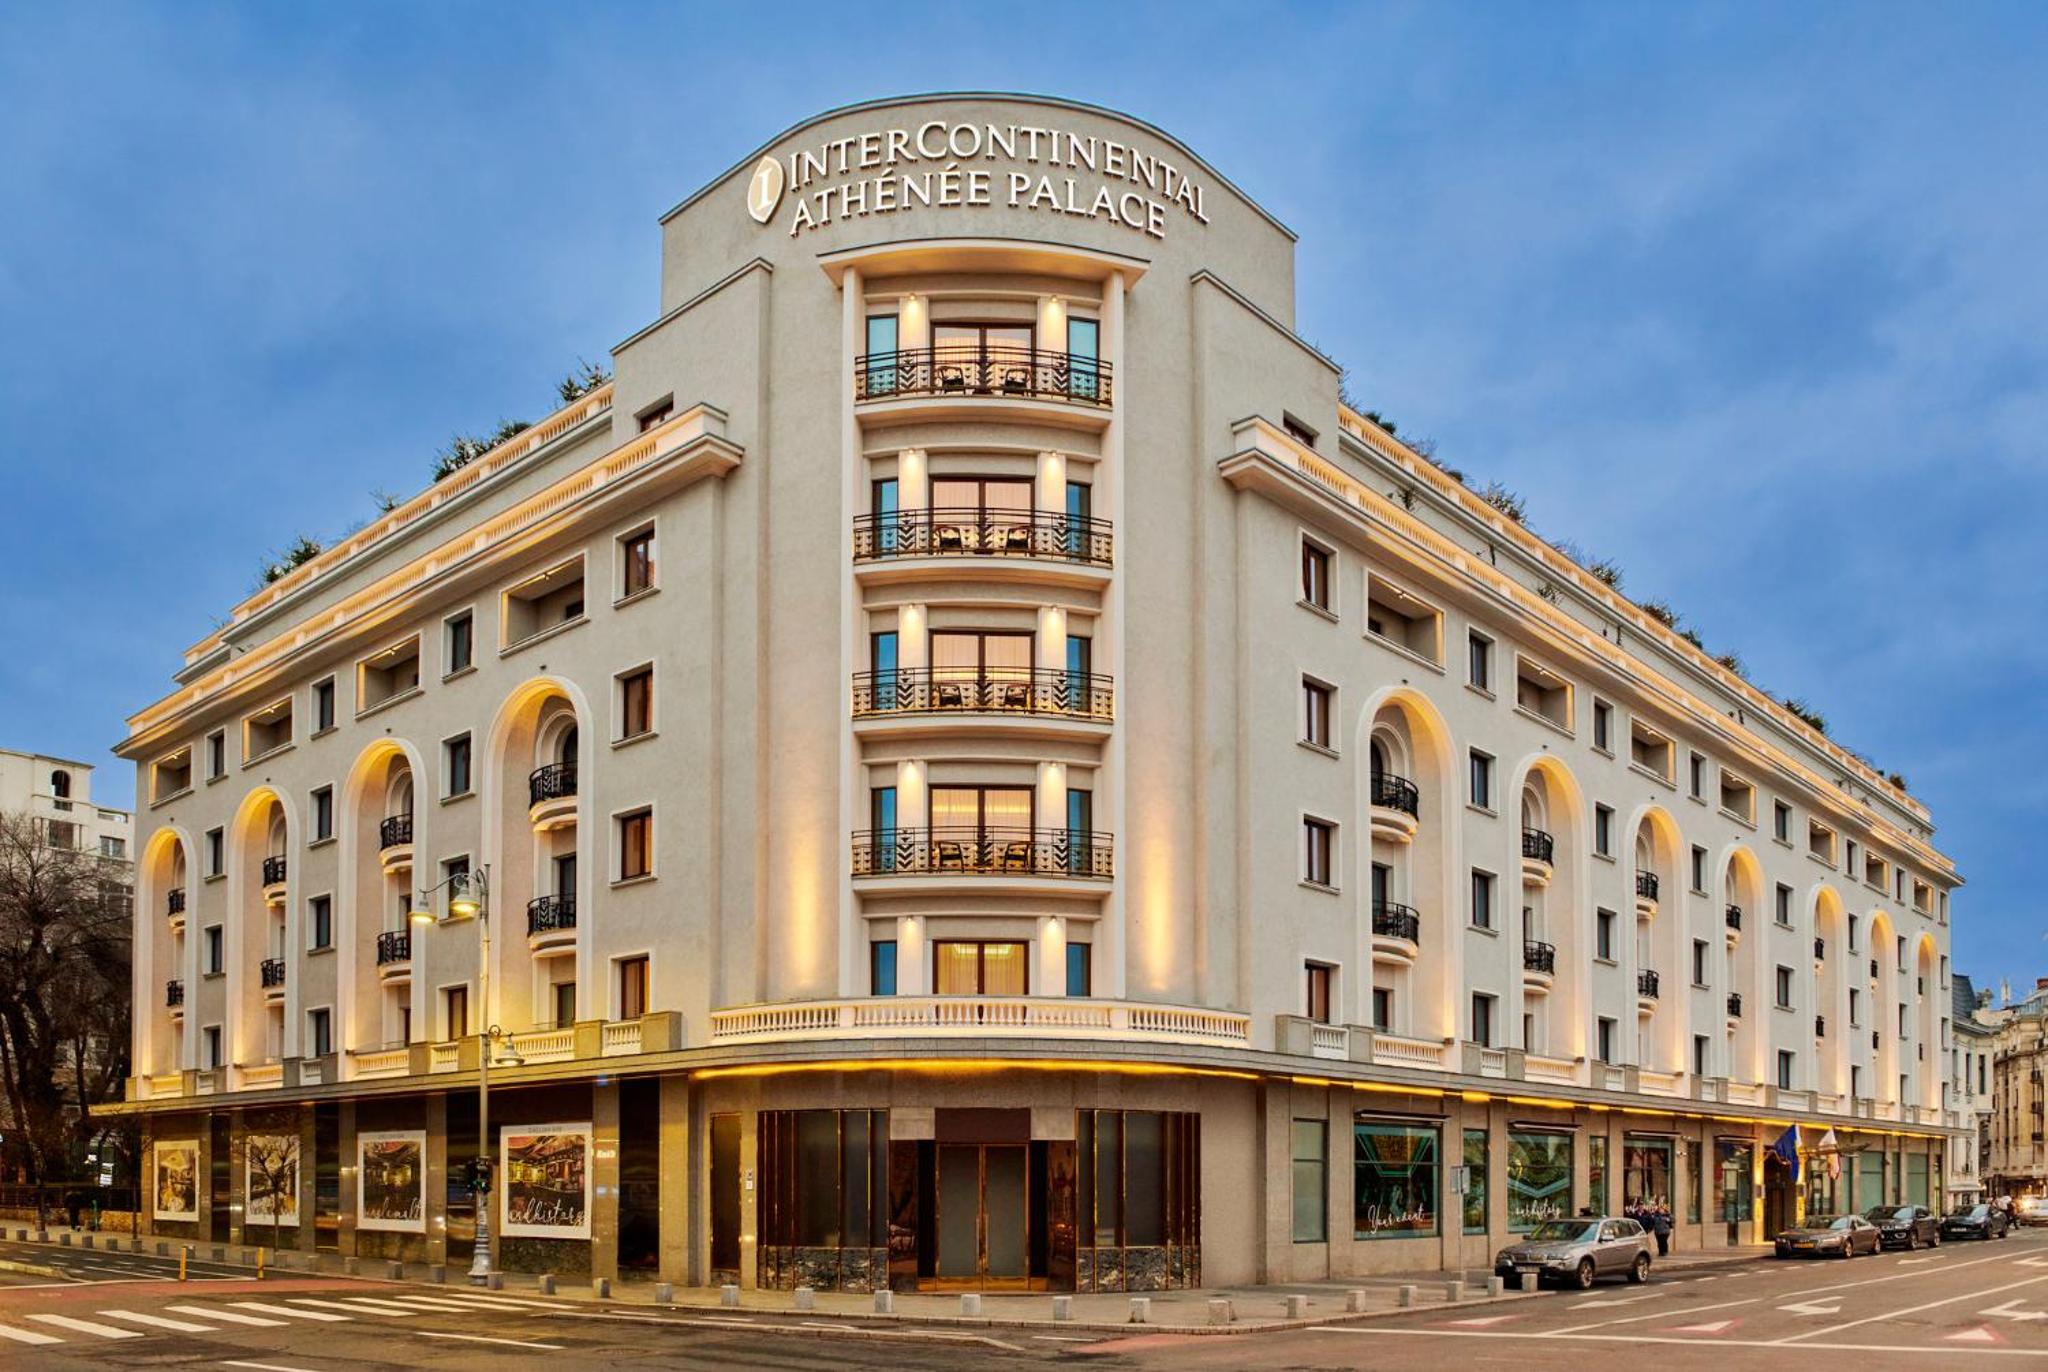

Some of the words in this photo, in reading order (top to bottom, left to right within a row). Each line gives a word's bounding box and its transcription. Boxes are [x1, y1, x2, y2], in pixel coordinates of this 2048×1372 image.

[789, 121, 1210, 224] INTERCONTINENTAL
[789, 162, 991, 237] ATHÉNÉE
[1007, 172, 1166, 239] PALACE
